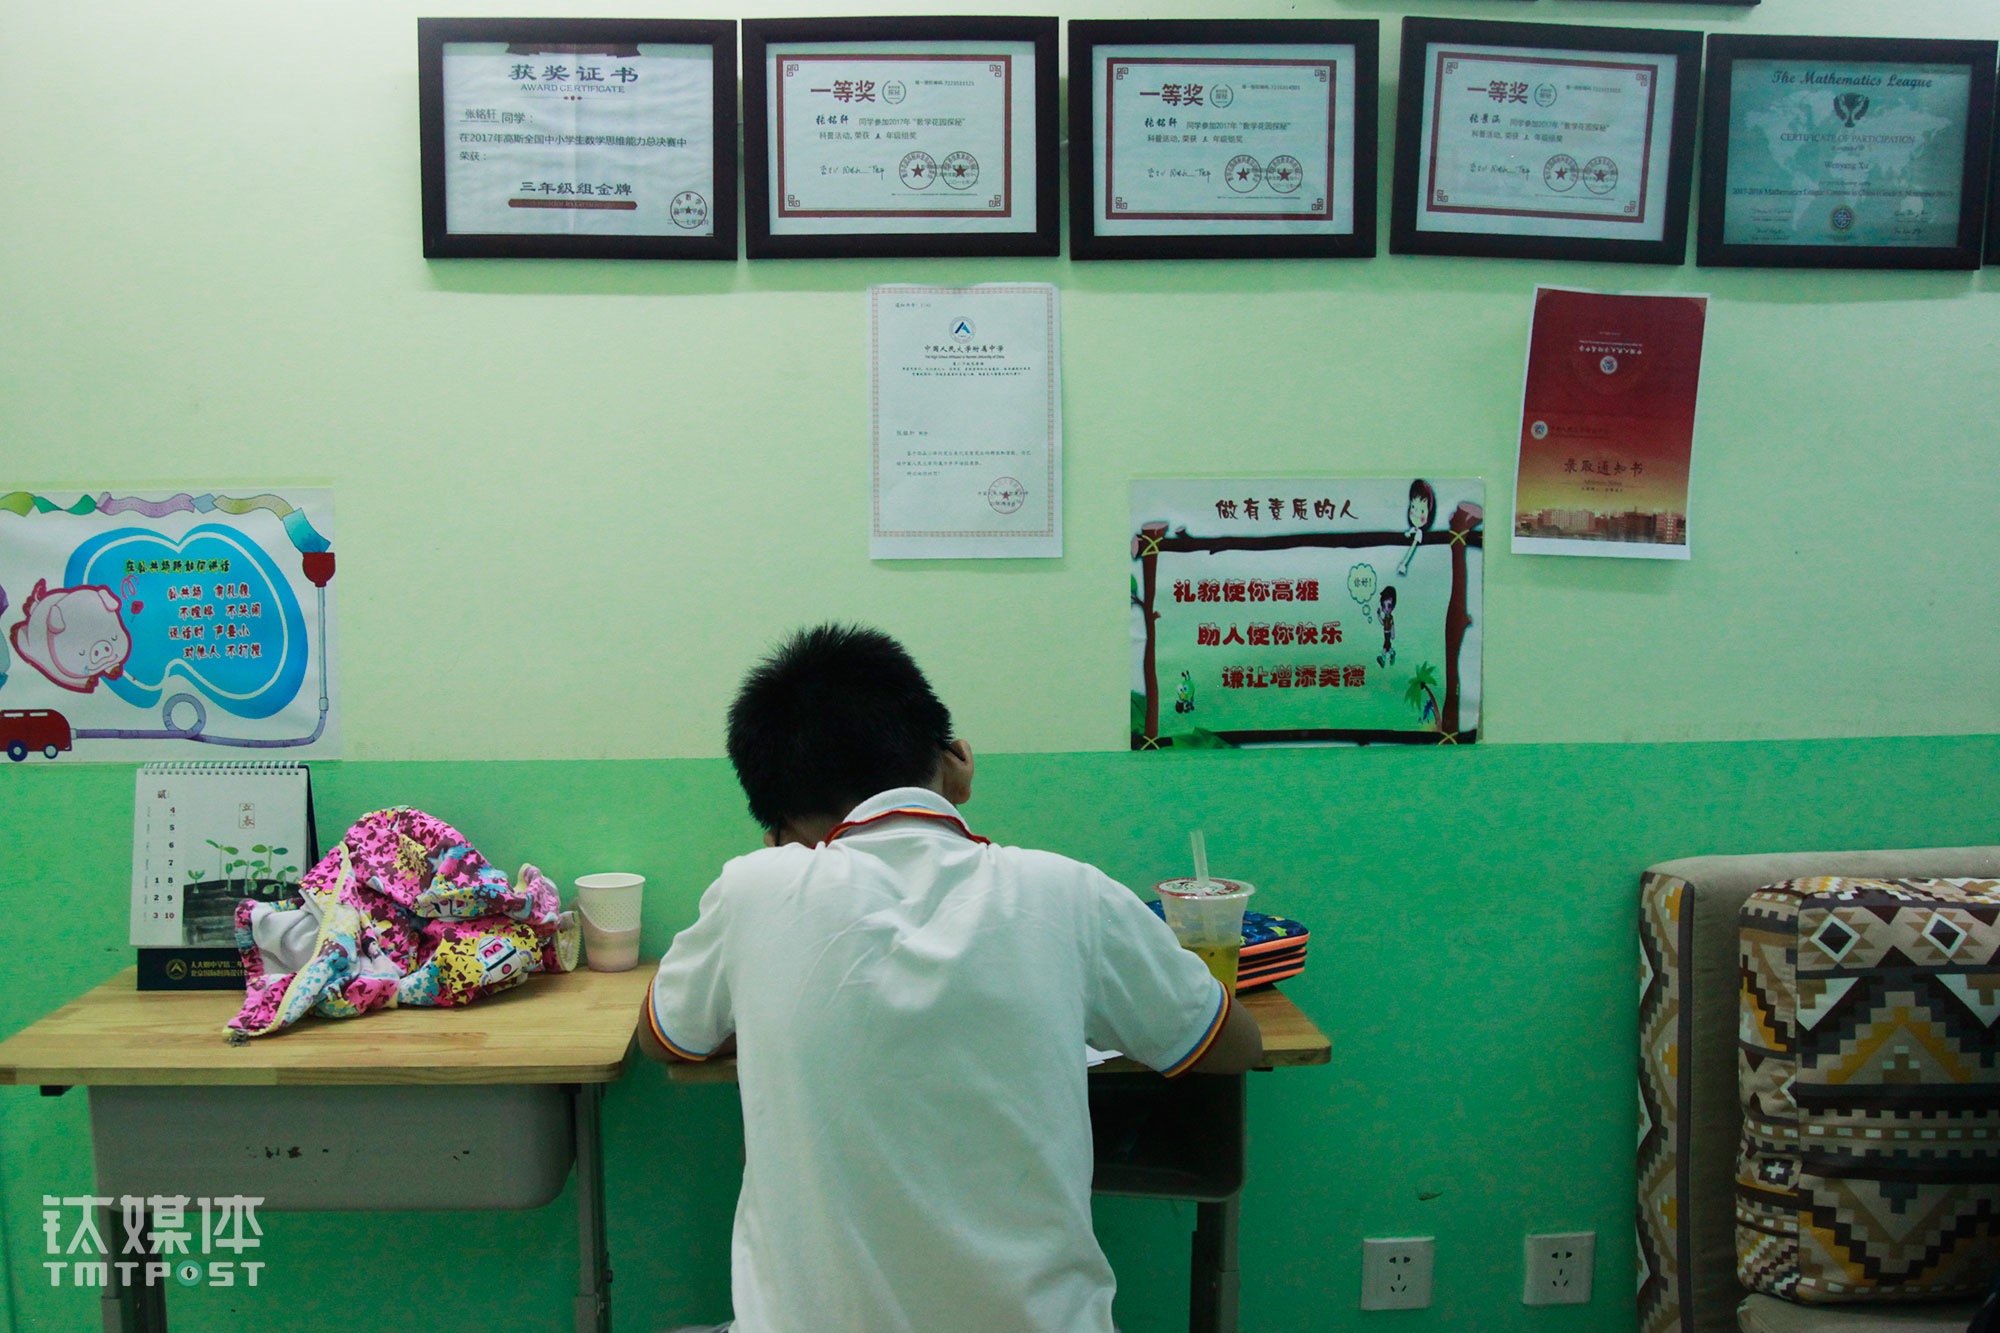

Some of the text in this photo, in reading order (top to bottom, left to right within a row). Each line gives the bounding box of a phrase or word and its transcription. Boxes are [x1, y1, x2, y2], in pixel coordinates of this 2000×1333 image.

[508, 64, 639, 83] 获奖证书
[1771, 70, 1933, 90] The Mathematics League
[520, 84, 625, 93] AWARD CERTIFICATE
[810, 80, 876, 103] 一等奖
[1140, 83, 1204, 107] 一等奖
[1467, 80, 1529, 104] 一等奖
[1780, 133, 1916, 143] CERTIFICATE OF PARTICIPATION
[520, 182, 633, 196] 三年级组金牌
[1215, 498, 1359, 520] 做有素质的人
[1173, 578, 1319, 603] 礼貌使你高雅
[1197, 621, 1342, 646] 助人使你快乐
[1222, 664, 1366, 689] 谦让增添美德
[169, 806, 176, 814] 4
[168, 841, 175, 849] 6
